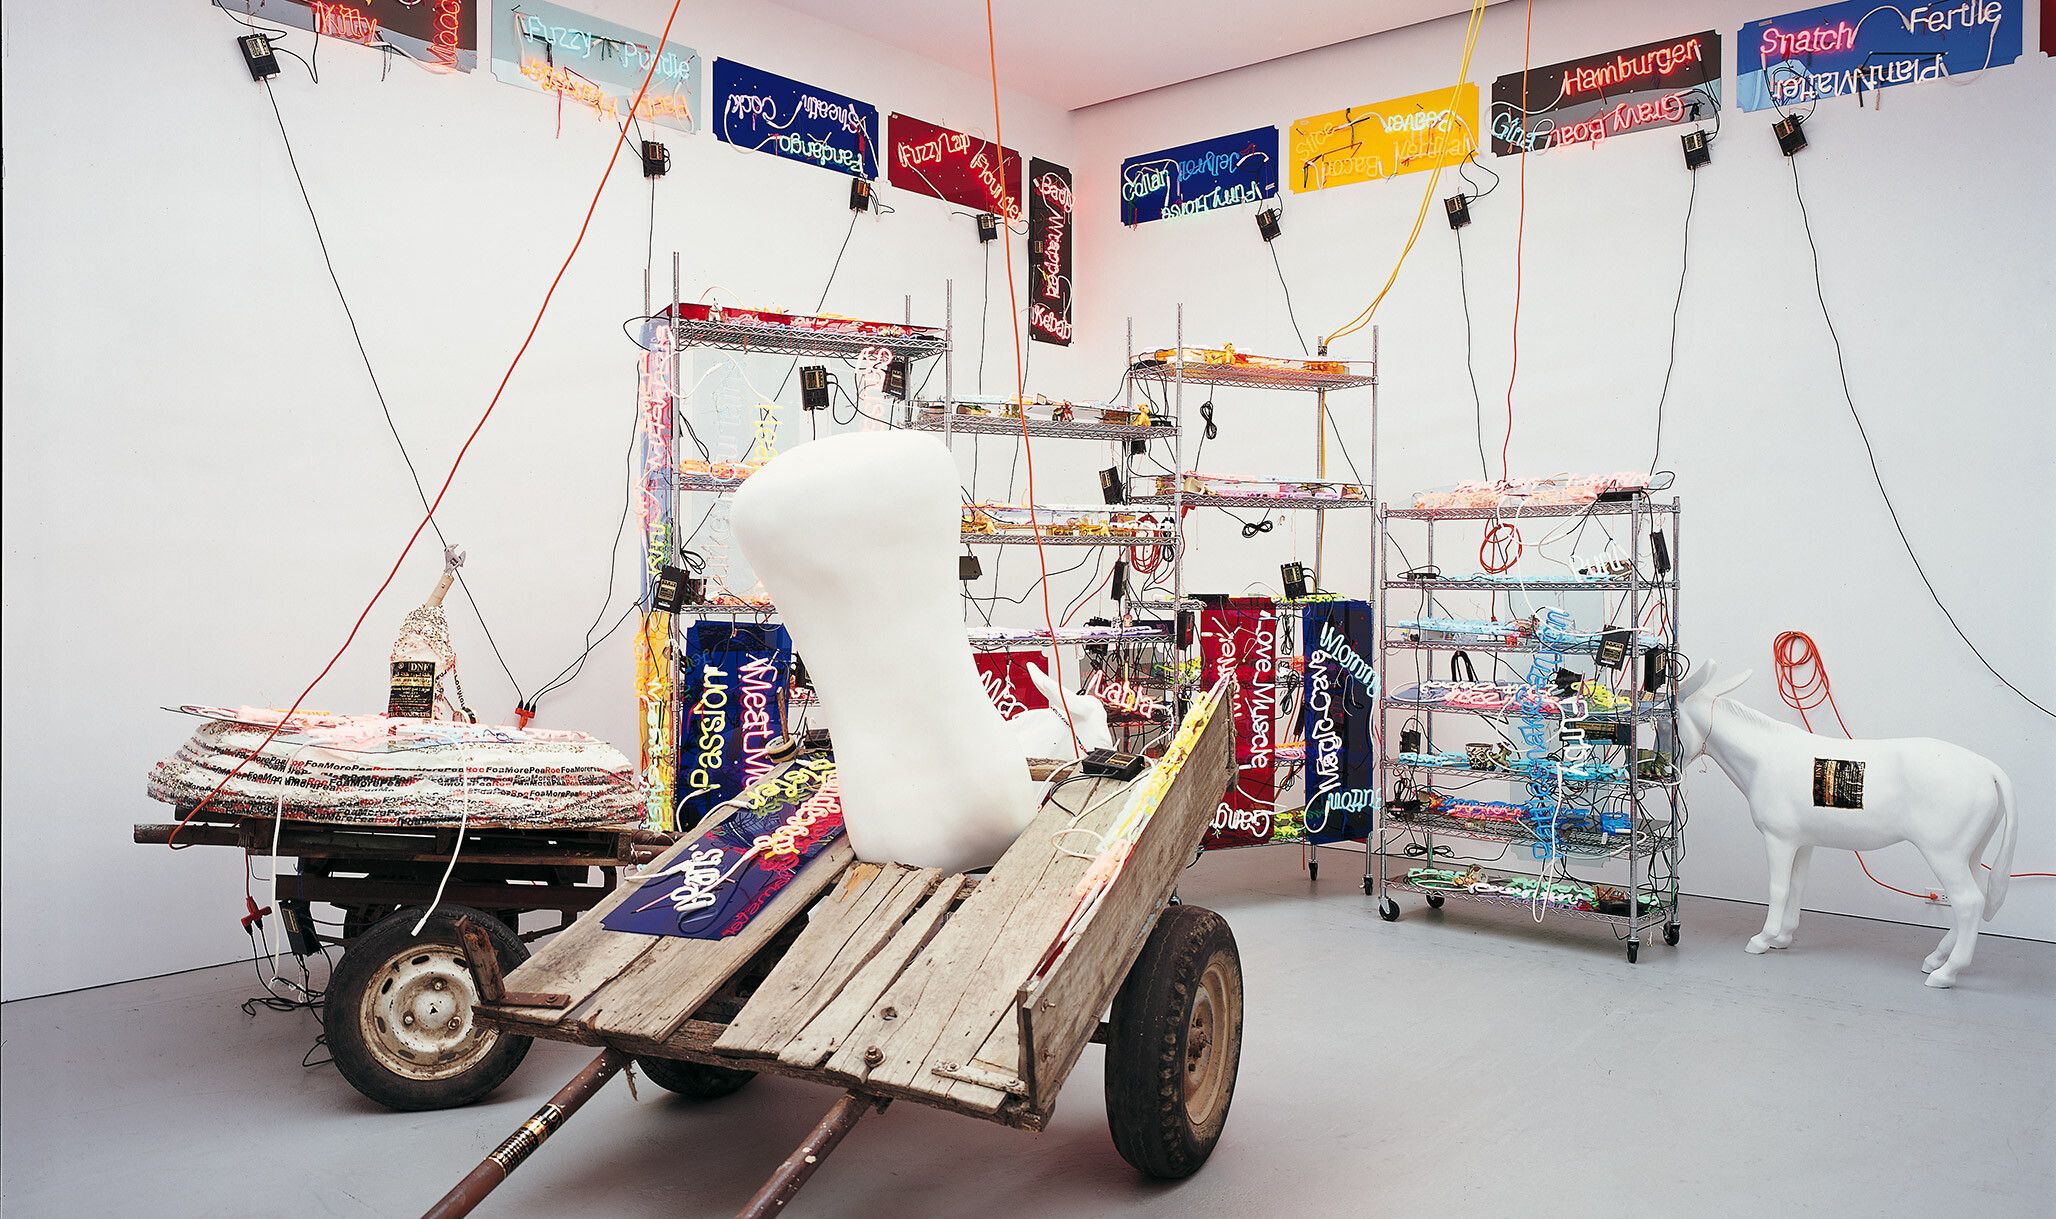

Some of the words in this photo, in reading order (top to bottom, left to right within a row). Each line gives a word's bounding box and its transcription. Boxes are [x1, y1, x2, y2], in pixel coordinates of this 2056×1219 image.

[318, 1, 377, 46] Kitty
[527, 16, 592, 58] Fuzzy
[1759, 20, 1854, 55] Snatch
[1564, 38, 1700, 96] Hamburger
[728, 94, 777, 120] Cock
[802, 94, 860, 133] Sheath
[1385, 109, 1455, 133] Beaver
[1613, 93, 1685, 131] Gravy
[1296, 122, 1336, 157] Slice
[1552, 117, 1606, 145] Boat
[779, 132, 863, 172] Fandango
[901, 141, 942, 167] Fuzzy
[1178, 151, 1240, 182] Jellyroll
[1122, 169, 1168, 201] Collar
[1032, 304, 1072, 339] Kebab
[1255, 610, 1274, 673] Love
[1309, 650, 1332, 713] Cave
[690, 665, 730, 790] Passion
[1252, 674, 1275, 769] Muscle
[1312, 718, 1342, 793] Magic
[1213, 801, 1272, 838] Gang
